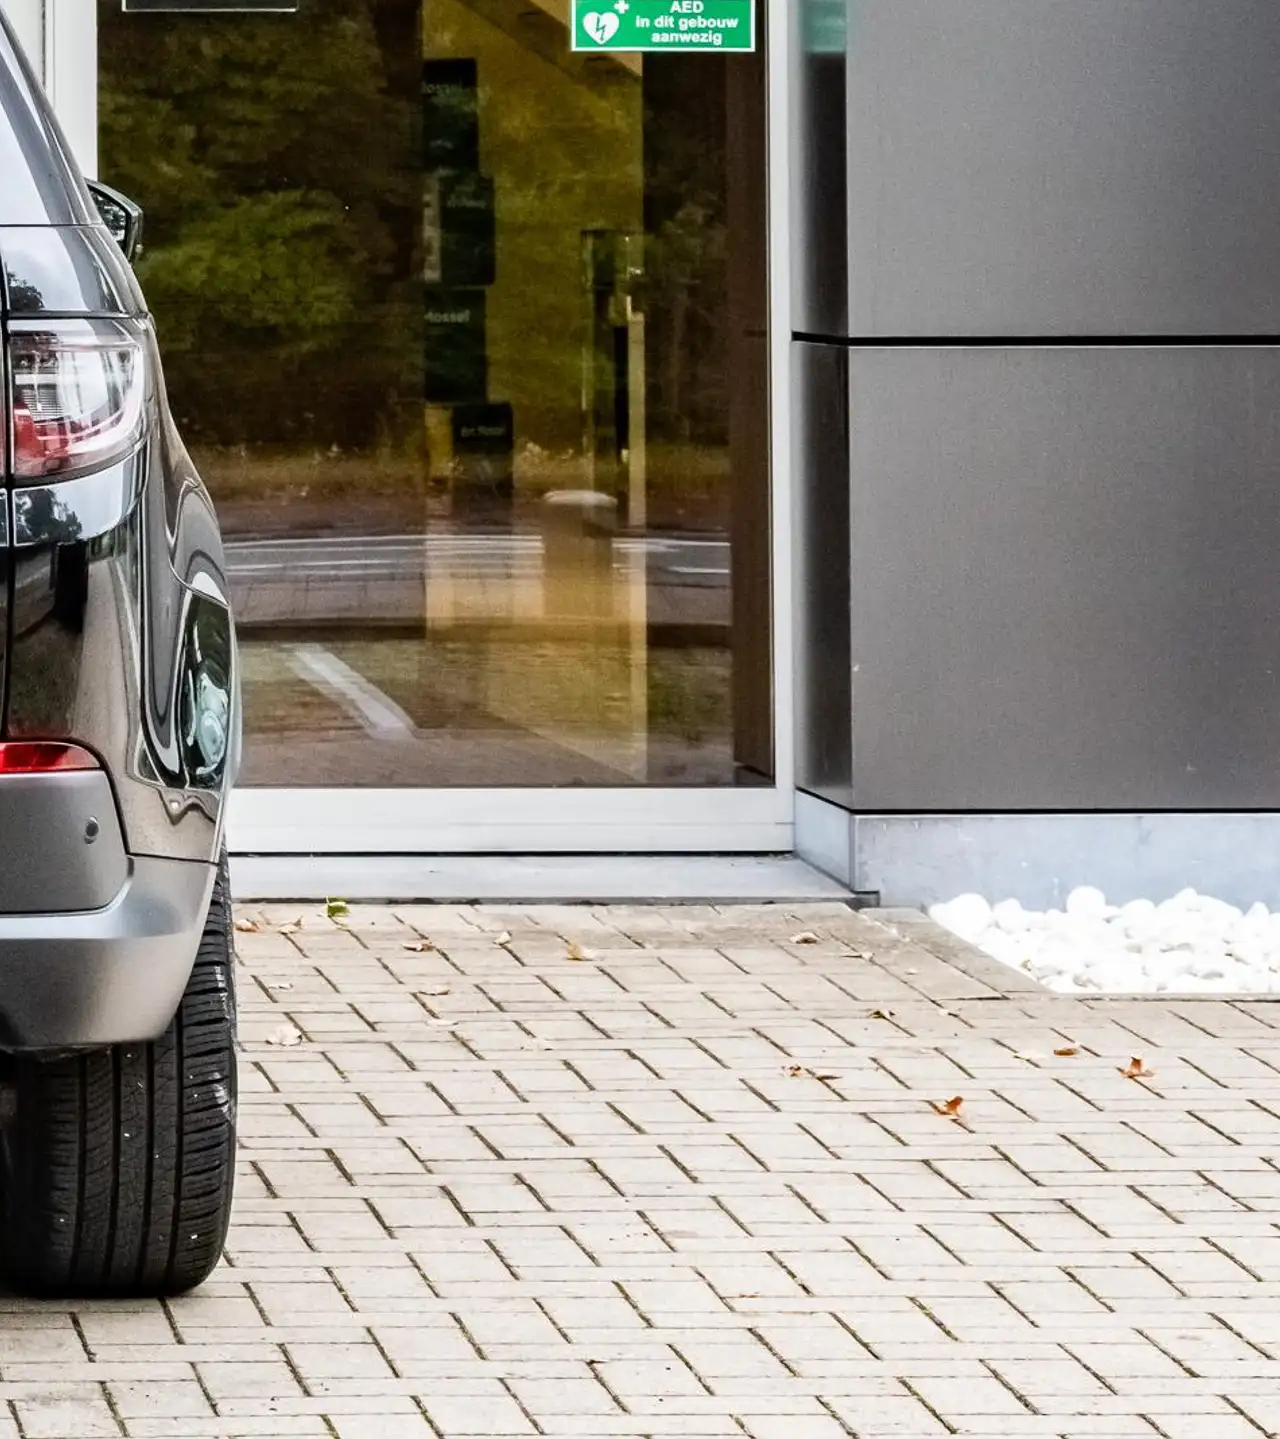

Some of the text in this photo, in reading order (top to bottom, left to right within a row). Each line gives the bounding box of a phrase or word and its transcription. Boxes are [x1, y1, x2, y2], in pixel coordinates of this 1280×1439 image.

[670, 0, 704, 13] AED
[654, 15, 674, 28] dit
[678, 15, 739, 30] gebouw
[651, 30, 723, 46] aanwezig
